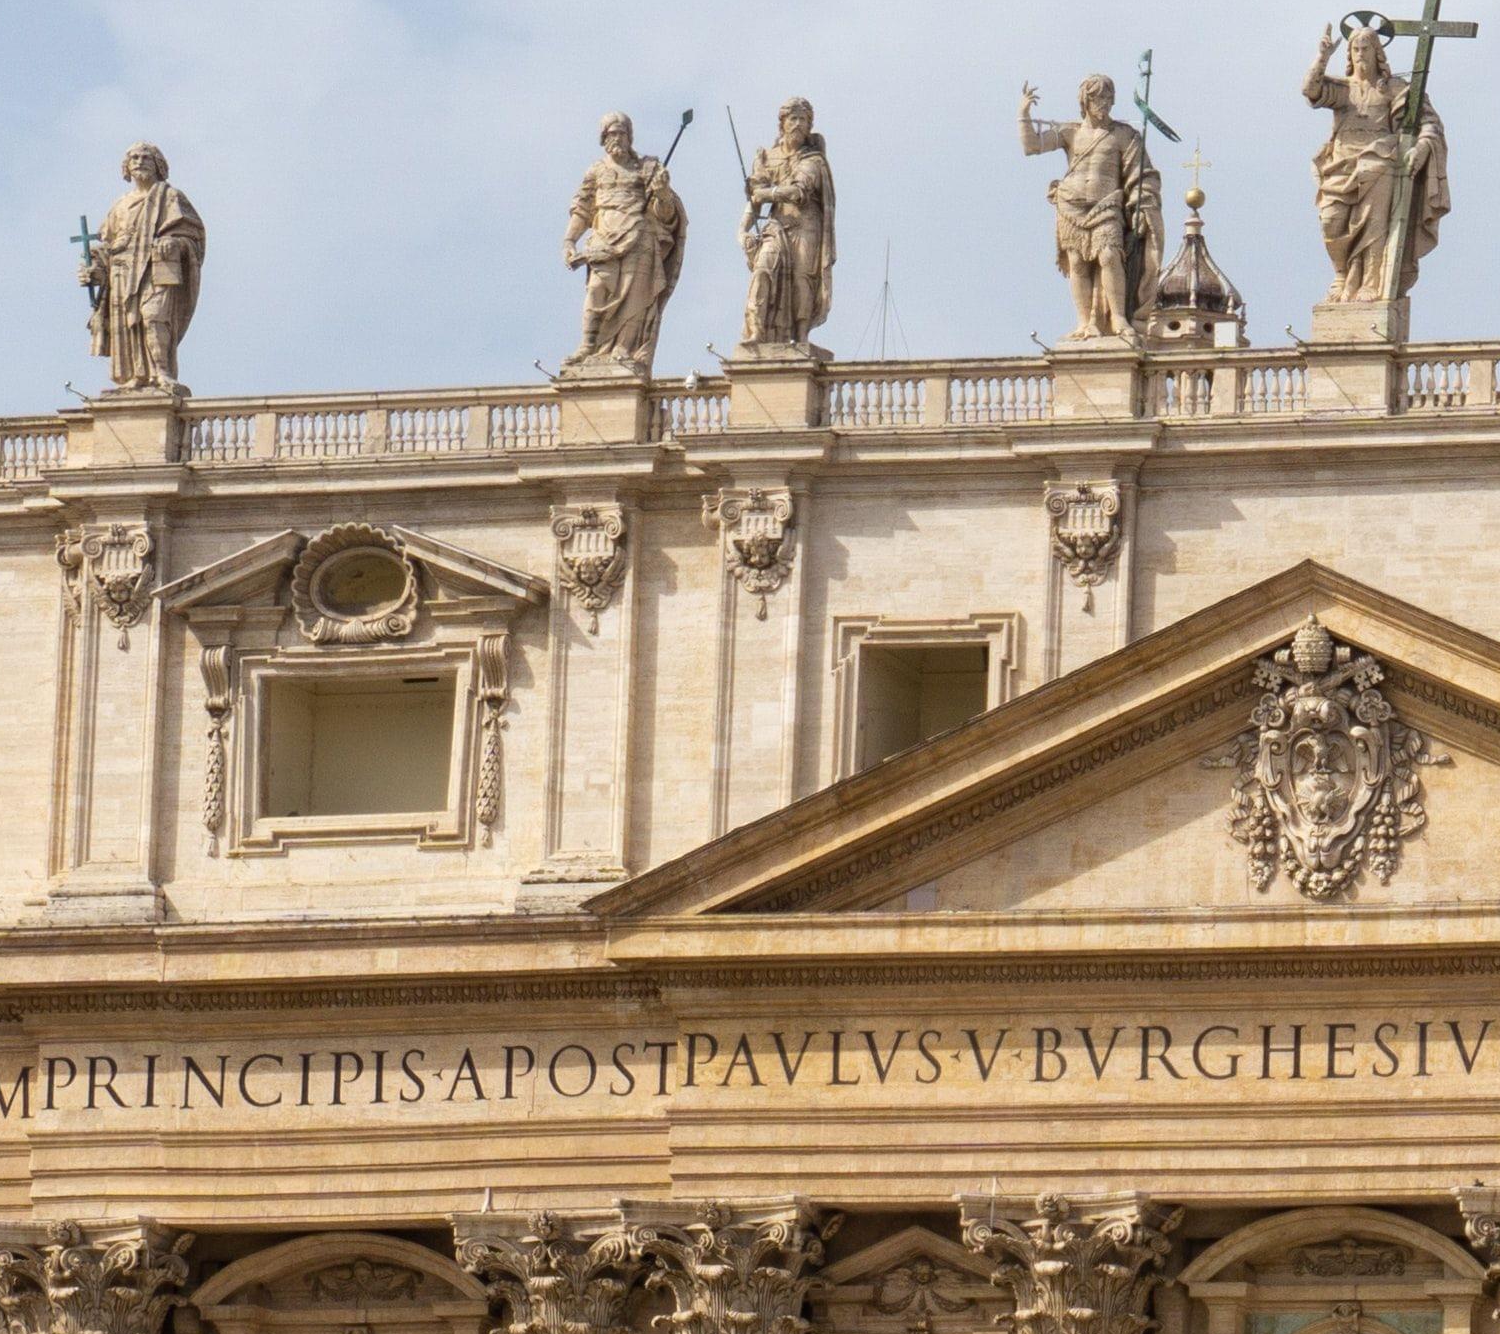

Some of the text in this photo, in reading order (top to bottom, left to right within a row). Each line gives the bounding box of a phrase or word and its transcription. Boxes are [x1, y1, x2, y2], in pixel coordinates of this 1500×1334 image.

[42, 1047, 426, 1111] PRINCIPIS
[442, 1040, 679, 1102] APOST
[682, 1027, 944, 1088] PAVLVS
[960, 1027, 1008, 1084] V
